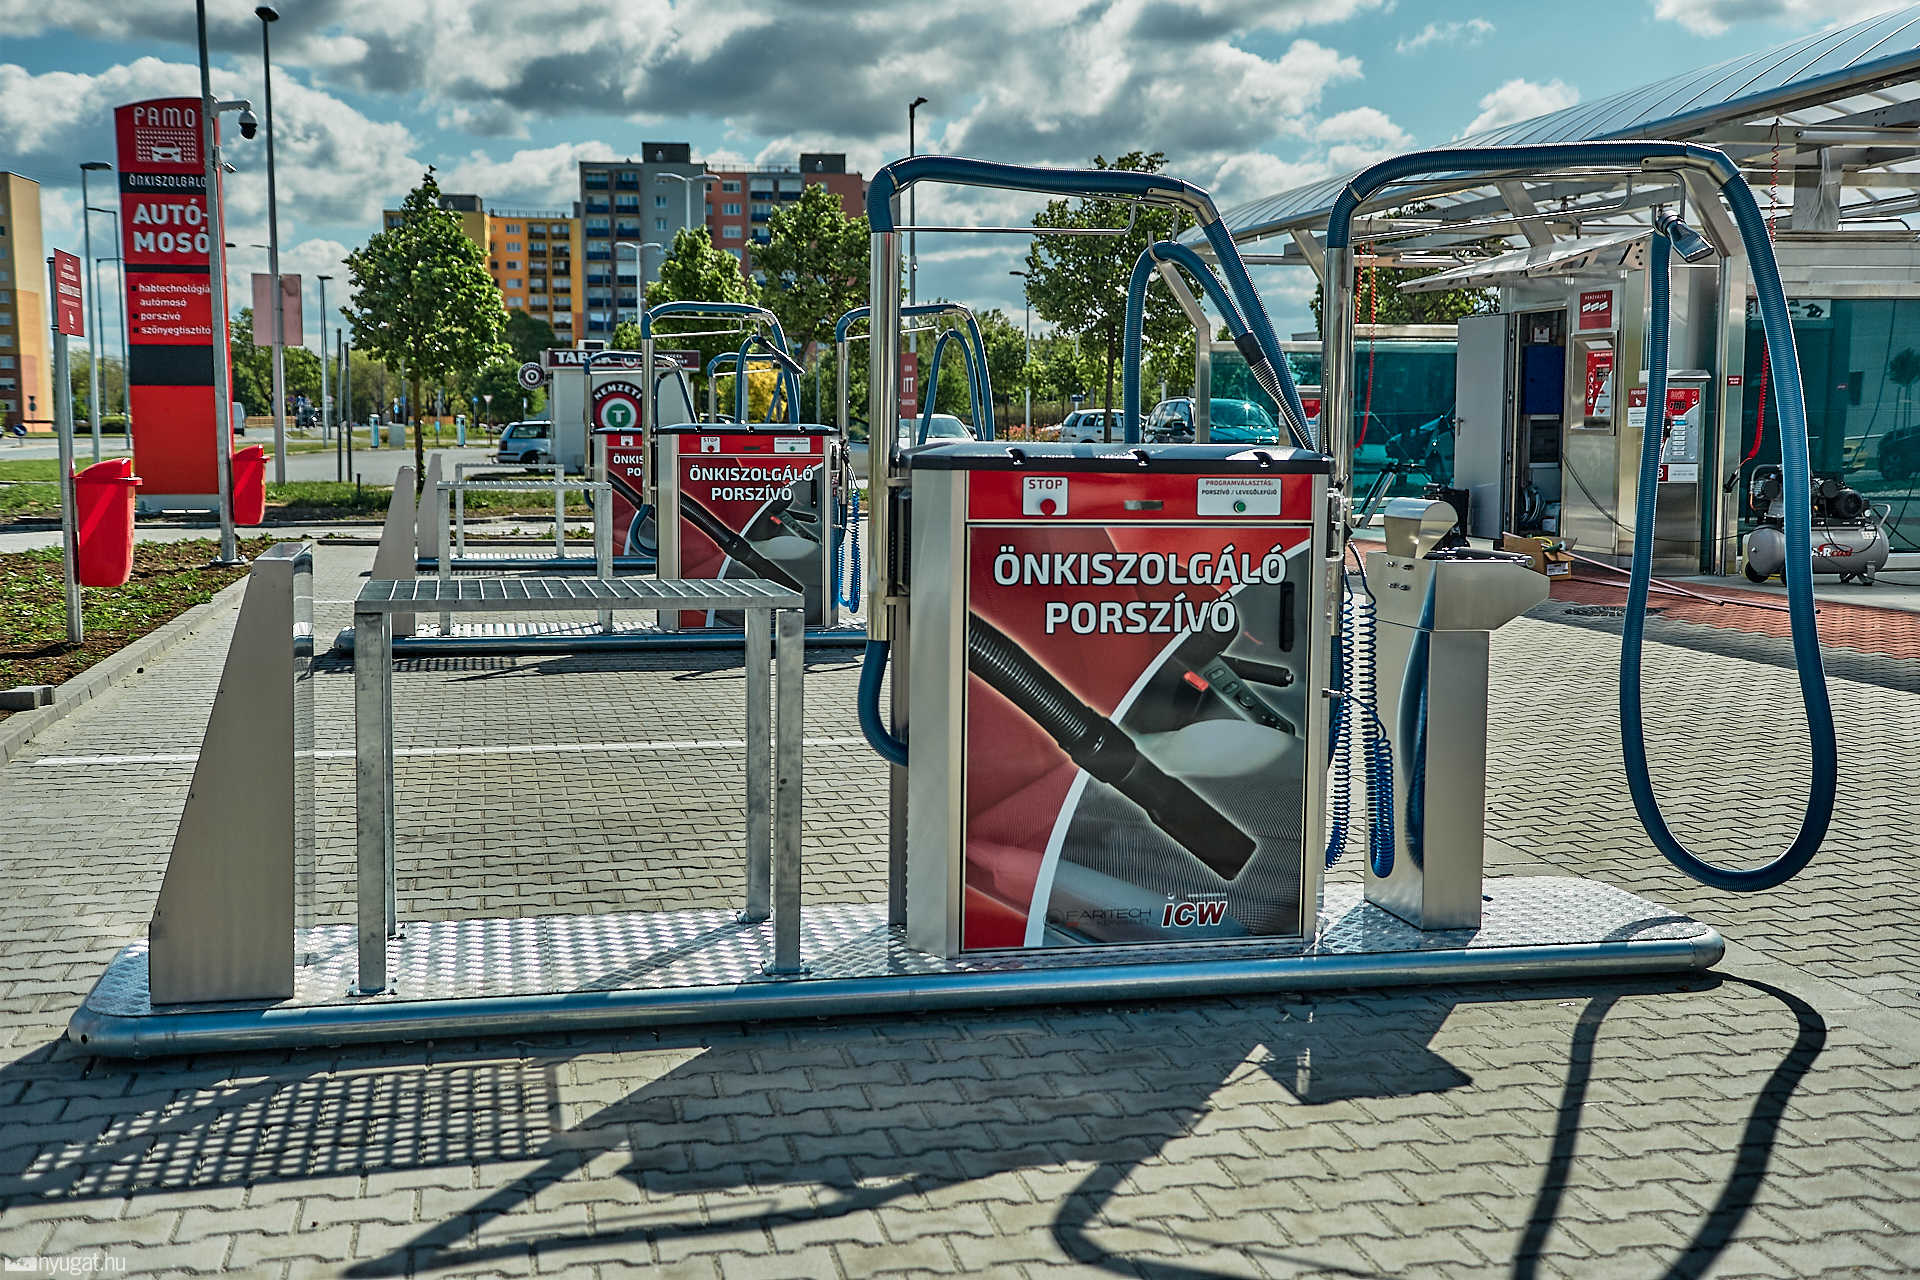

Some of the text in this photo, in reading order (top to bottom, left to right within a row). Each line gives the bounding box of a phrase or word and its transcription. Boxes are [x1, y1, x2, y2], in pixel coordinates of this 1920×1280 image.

[134, 107, 196, 127] PAMO
[133, 226, 210, 253] MOSÓ
[140, 298, 187, 307] autómosó
[140, 312, 181, 321] porszívó
[594, 383, 642, 400] NEMZETI
[689, 464, 814, 481] ÖNKISZOLGÁLÓ
[711, 484, 793, 501] PORSZÍVÓ
[1028, 479, 1063, 490] STOP
[994, 544, 1287, 586] ÖNKISZOLGÁLÓ
[1045, 592, 1237, 634] PORSZÍVÓ
